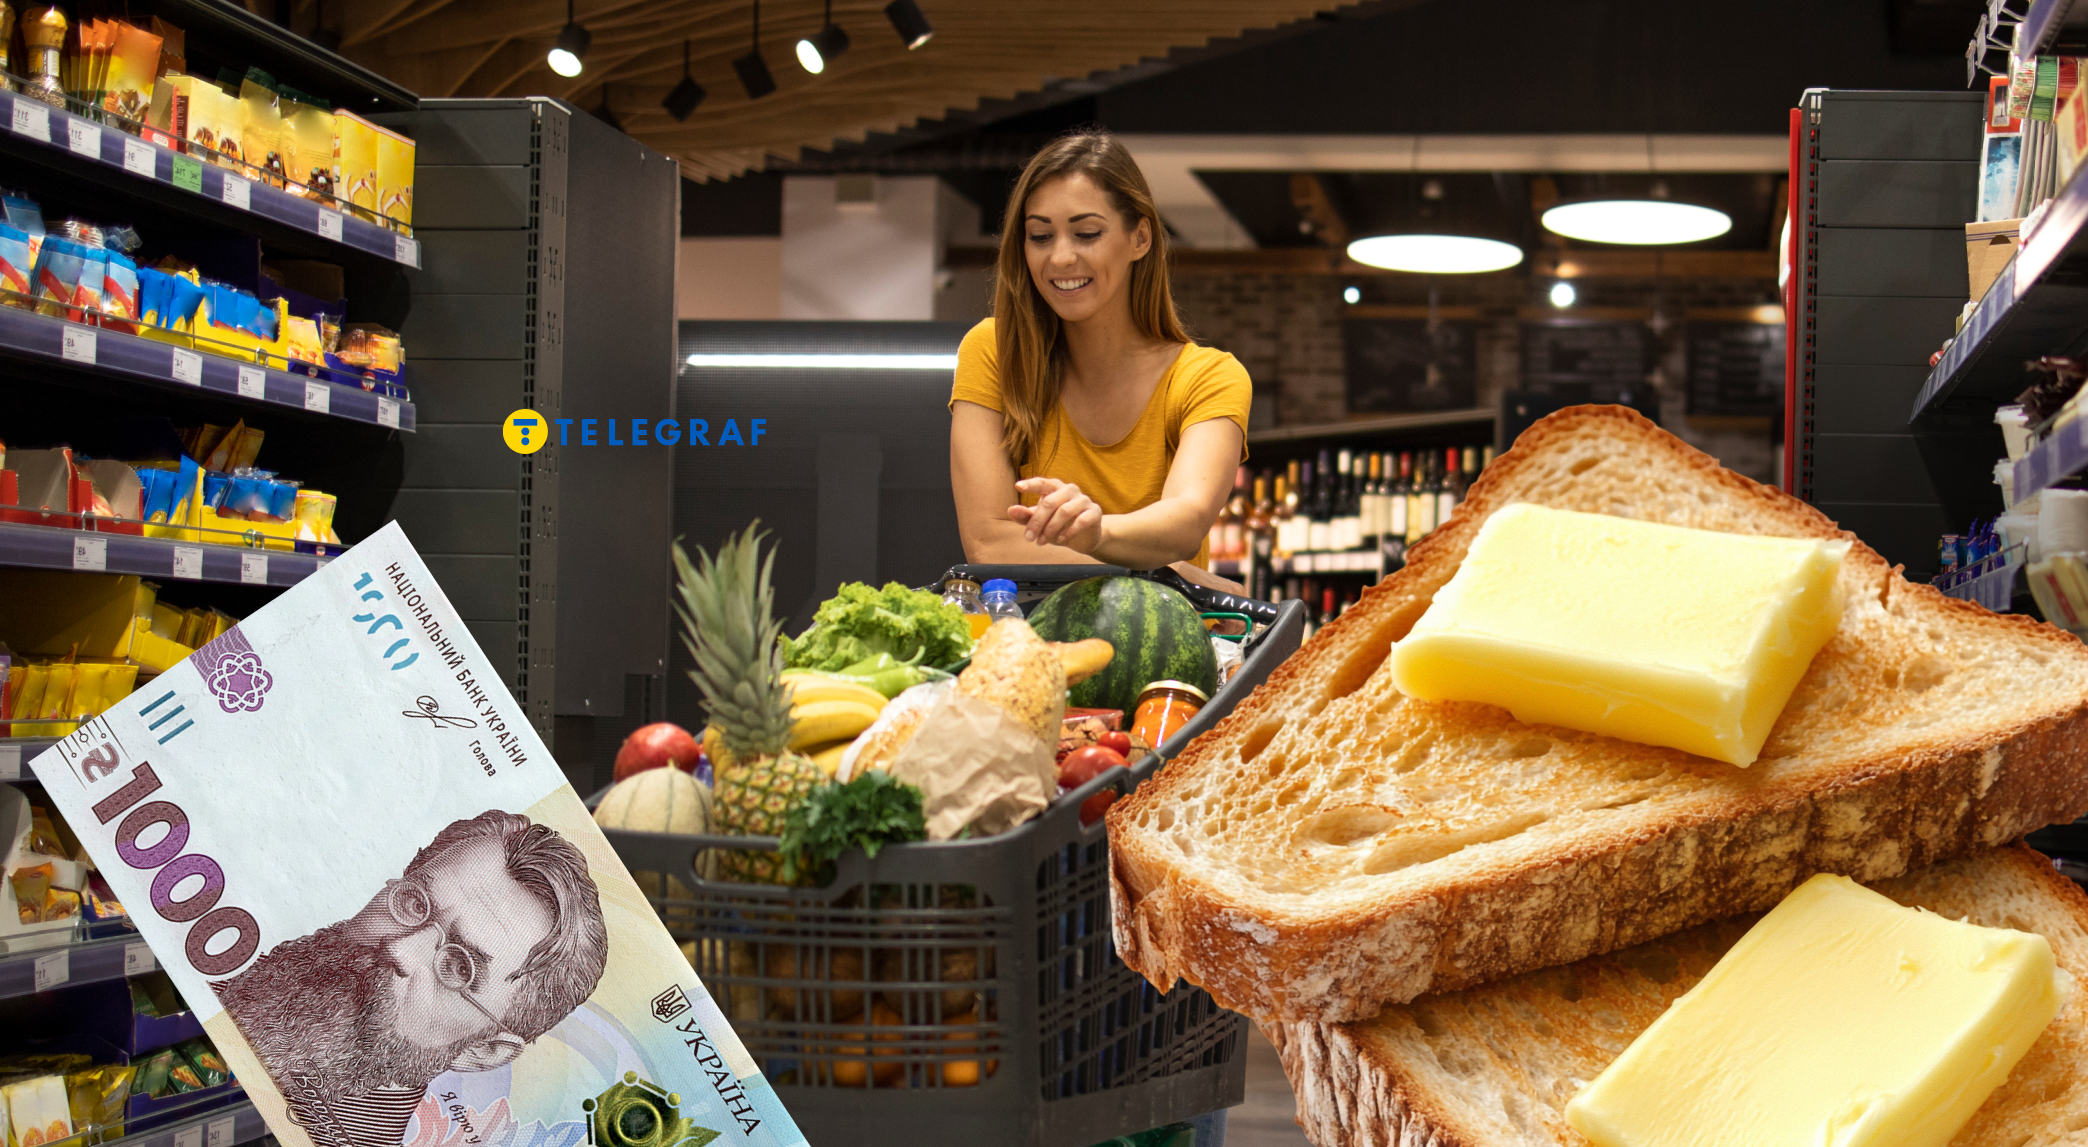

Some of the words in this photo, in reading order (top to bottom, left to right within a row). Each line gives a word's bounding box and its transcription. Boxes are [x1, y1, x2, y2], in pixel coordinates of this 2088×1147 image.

[385, 561, 466, 670] НАЦІОНАЛЬНИЙ
[456, 668, 488, 709] БАНК
[481, 705, 528, 768] УКРАЇНИ
[468, 739, 497, 777] Голова
[91, 760, 260, 976] 1000
[675, 1017, 762, 1137] УКРАЇНА
[440, 1091, 458, 1103] Я
[448, 1103, 474, 1134] вірю
[465, 1134, 482, 1145] у
